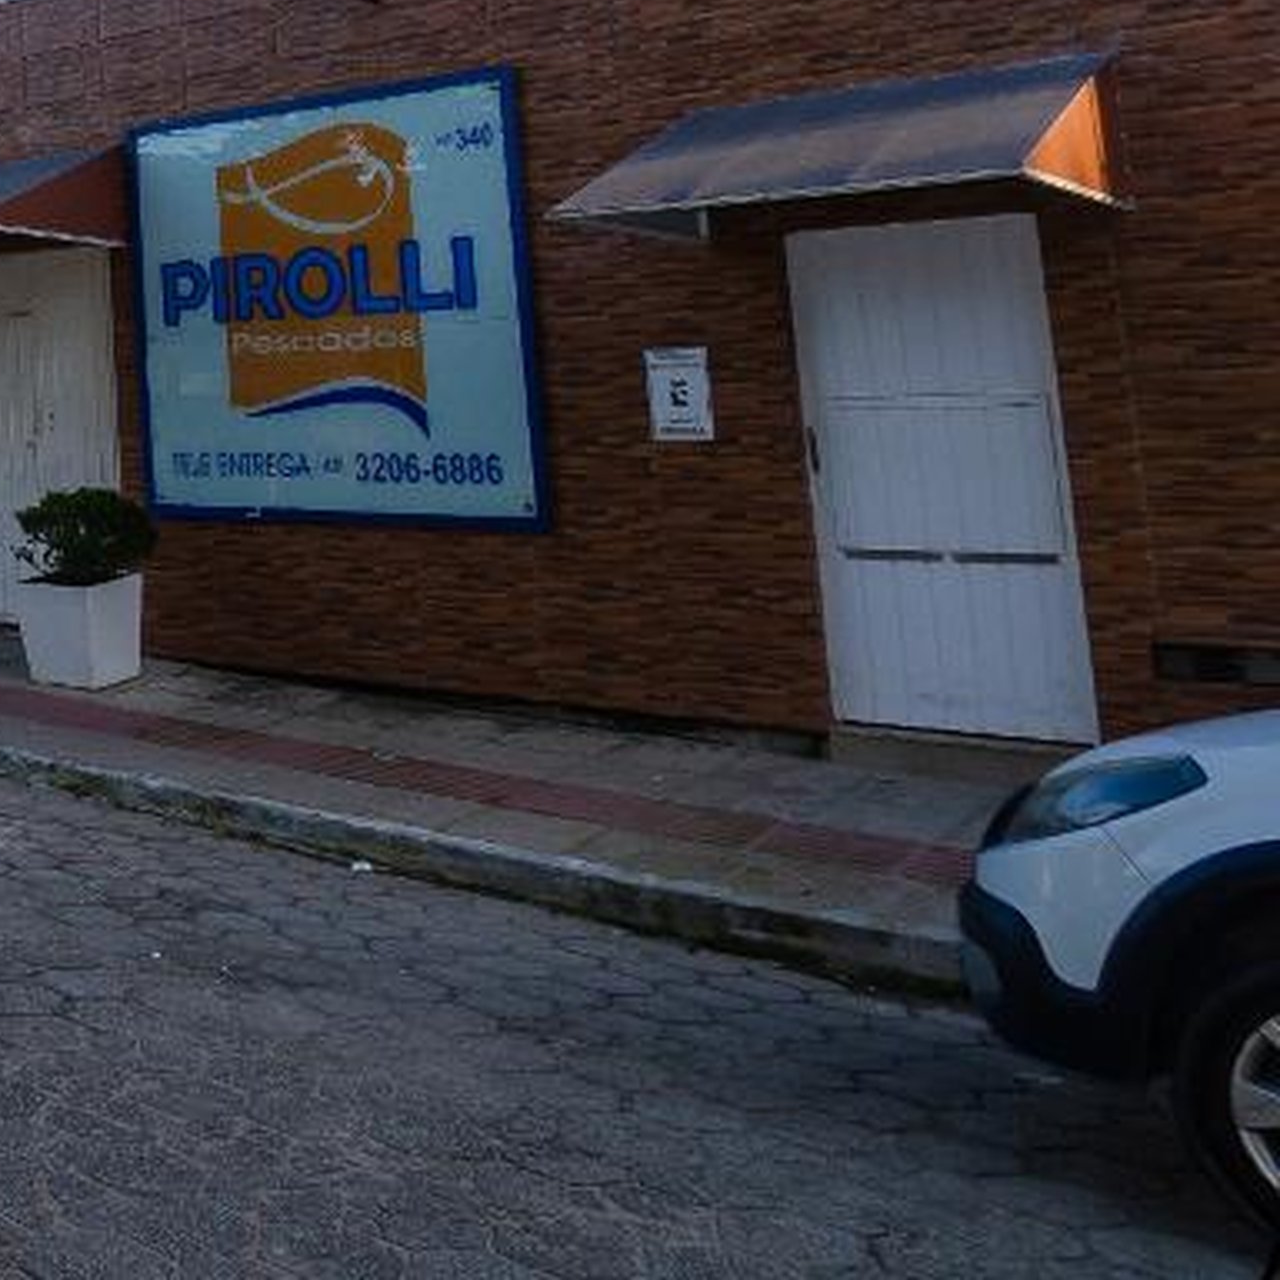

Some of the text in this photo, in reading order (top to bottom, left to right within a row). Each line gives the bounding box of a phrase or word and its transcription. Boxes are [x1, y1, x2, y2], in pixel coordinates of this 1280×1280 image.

[456, 121, 494, 151] 340
[160, 235, 478, 327] PIROLLI
[217, 452, 312, 478] ENTREGA
[355, 452, 504, 484] 3206-6886
